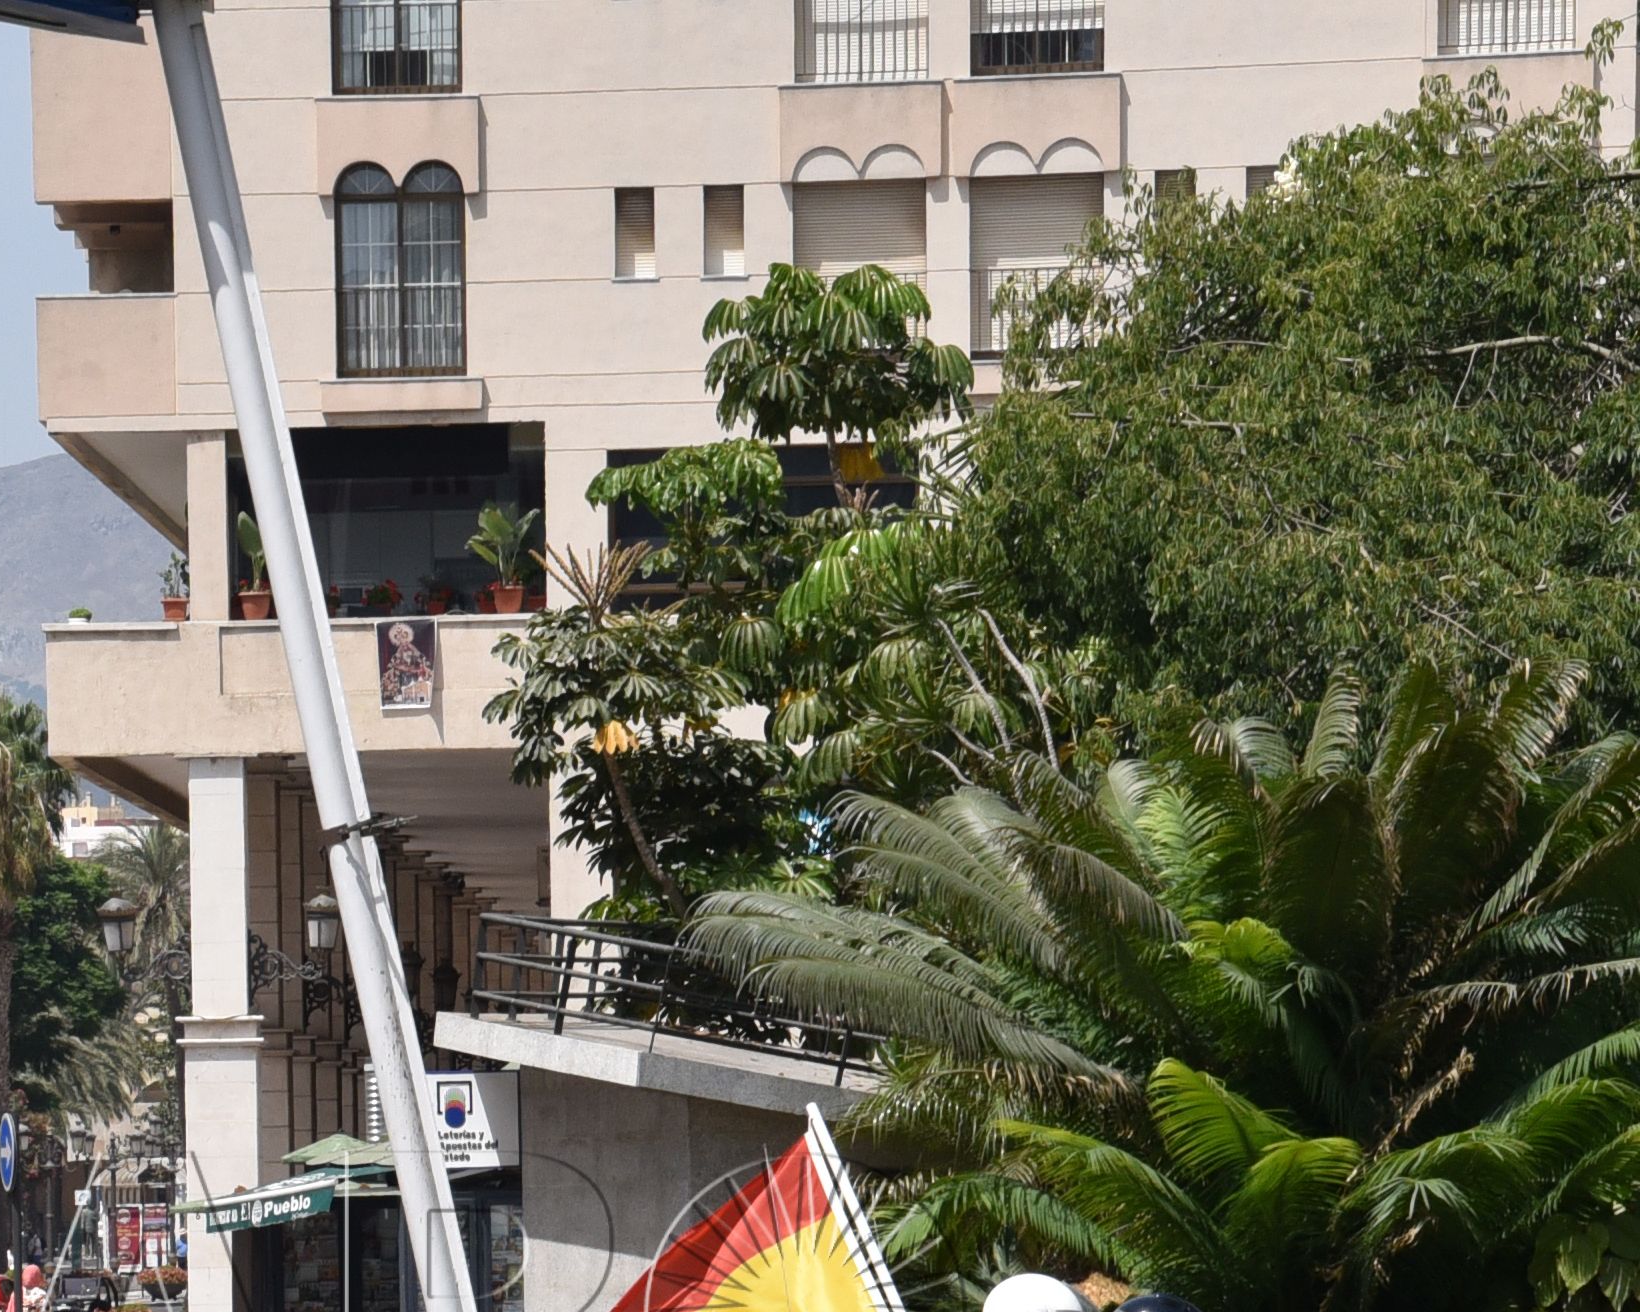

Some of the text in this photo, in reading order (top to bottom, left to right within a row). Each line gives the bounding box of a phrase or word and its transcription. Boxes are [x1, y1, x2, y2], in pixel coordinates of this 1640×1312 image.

[479, 1131, 484, 1141] y
[485, 1139, 499, 1150] del
[443, 1151, 471, 1162] stado
[263, 1194, 311, 1218] Pueblo
